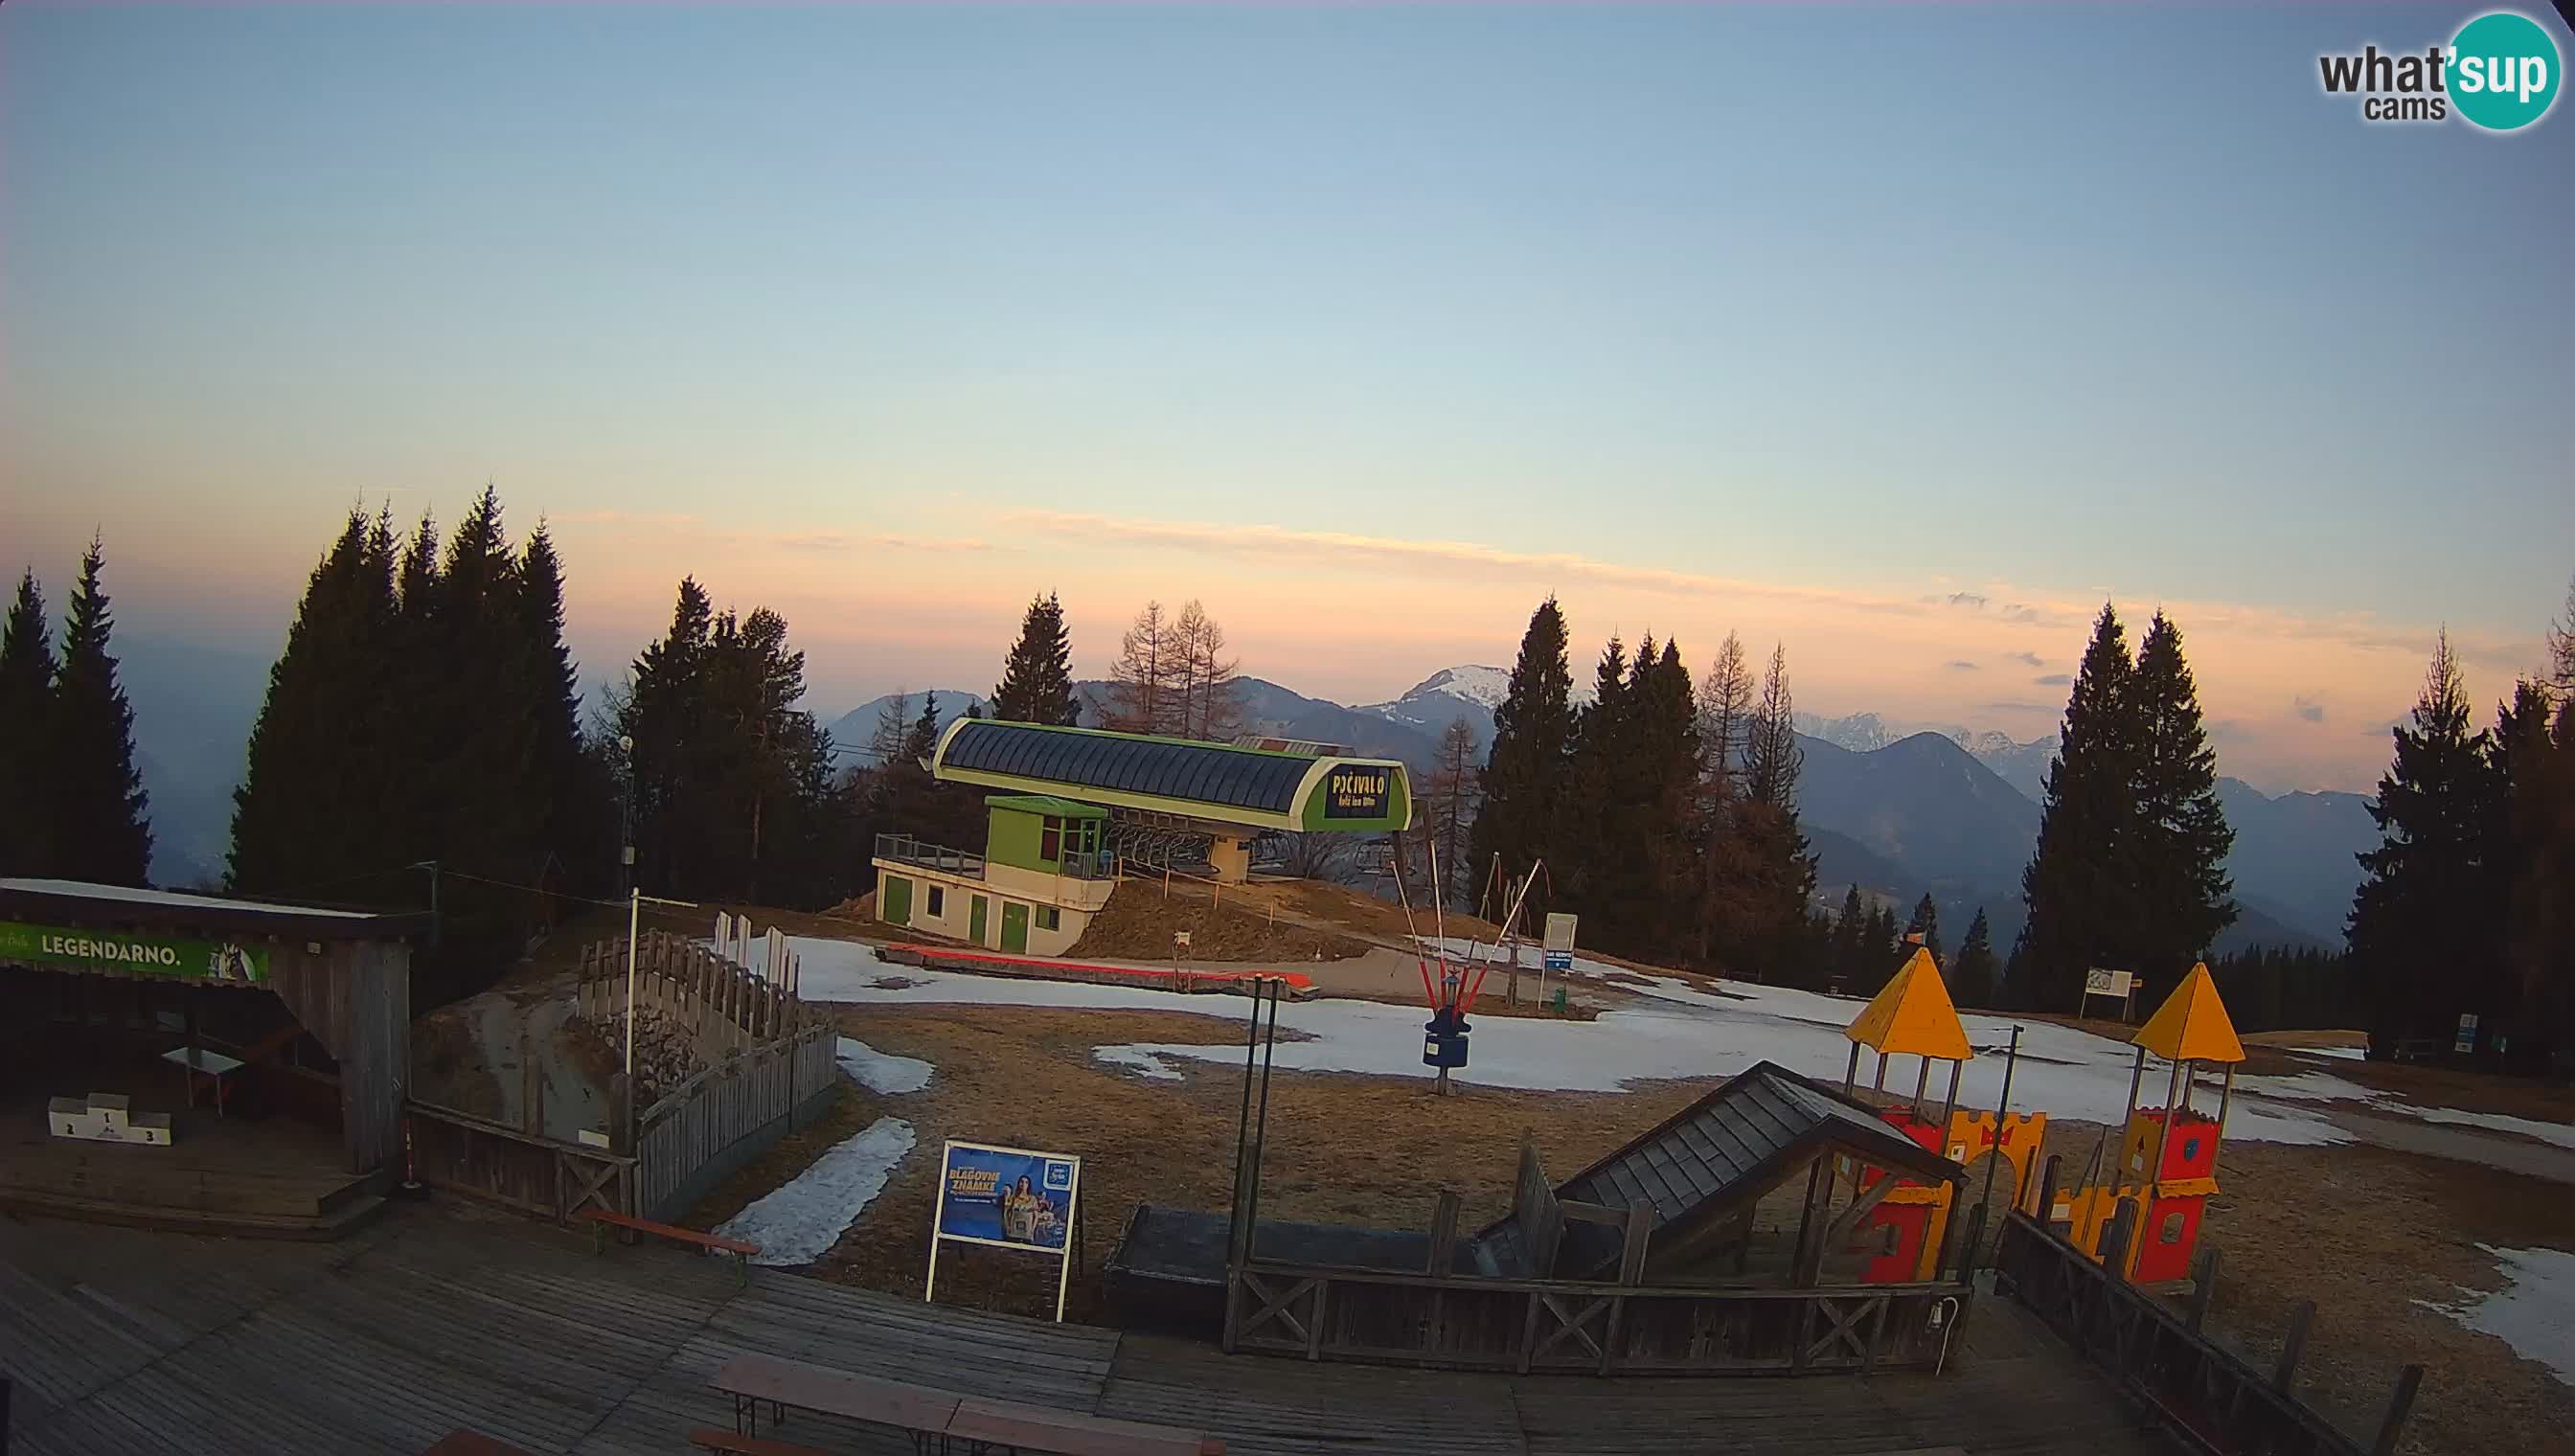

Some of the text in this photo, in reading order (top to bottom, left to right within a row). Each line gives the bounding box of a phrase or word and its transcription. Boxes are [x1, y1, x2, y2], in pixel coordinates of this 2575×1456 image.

[42, 935, 182, 967] LEGENDARNO.
[103, 1112, 111, 1124] 1
[66, 1124, 76, 1135] 2
[146, 1130, 154, 1142] 3
